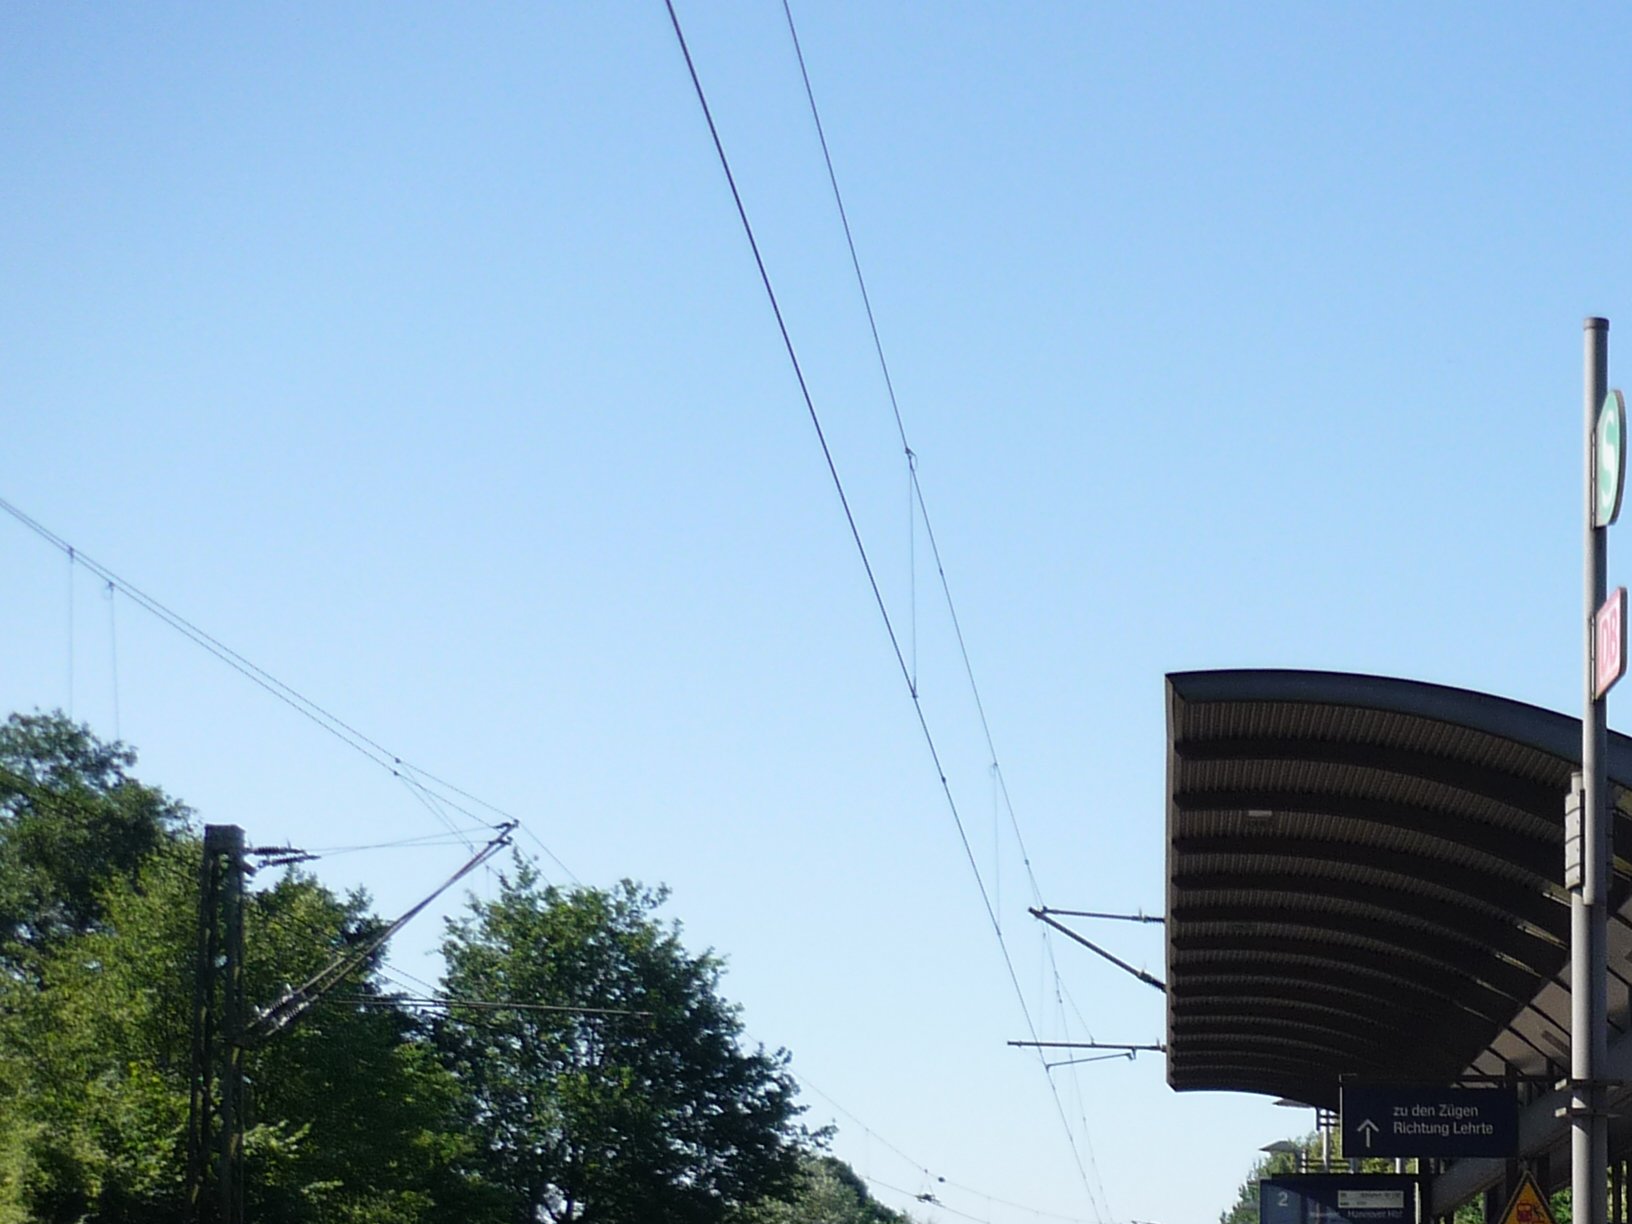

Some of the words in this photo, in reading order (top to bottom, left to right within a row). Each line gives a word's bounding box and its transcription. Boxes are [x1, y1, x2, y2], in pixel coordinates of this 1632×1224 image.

[1601, 411, 1618, 507] S
[1600, 610, 1618, 680] DB
[1393, 1107, 1408, 1117] zu
[1412, 1104, 1435, 1117] den
[1438, 1104, 1478, 1119] Zügen
[1393, 1122, 1449, 1136] Richtung
[1453, 1122, 1493, 1135] Lehrte
[1278, 1191, 1289, 1207] 2
